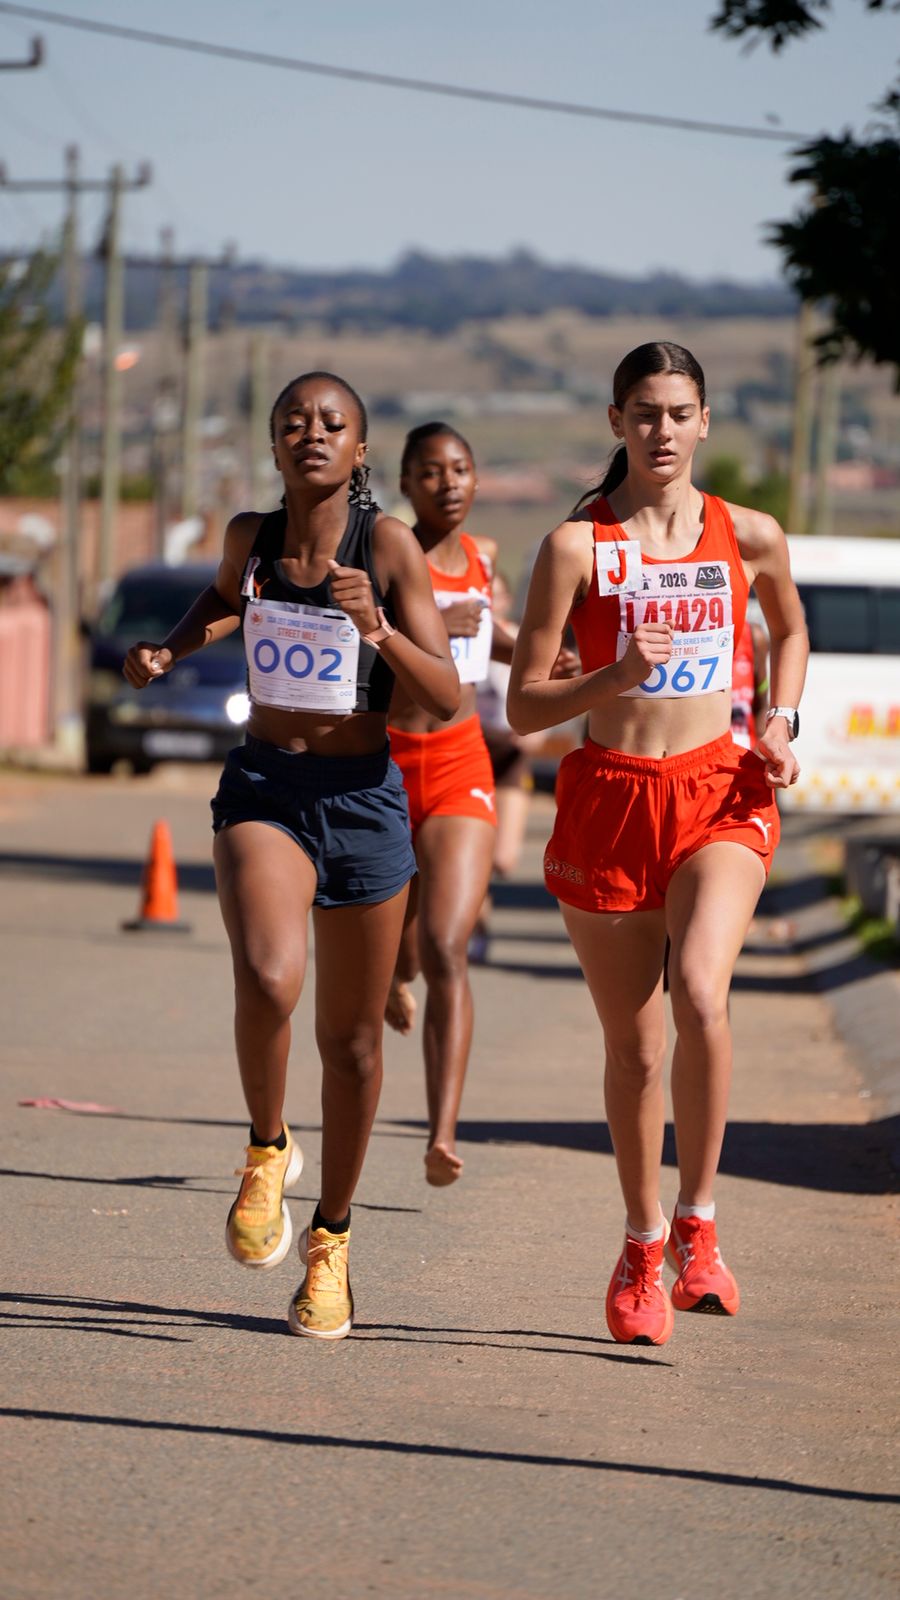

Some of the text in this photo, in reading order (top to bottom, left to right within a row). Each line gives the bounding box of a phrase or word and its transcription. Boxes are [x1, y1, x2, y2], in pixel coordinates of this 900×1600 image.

[607, 549, 627, 585] J
[698, 567, 722, 580] ASA
[659, 572, 688, 588] 2026
[277, 627, 317, 641] STREET MILE
[683, 645, 699, 655] MILE
[253, 638, 343, 682] 002
